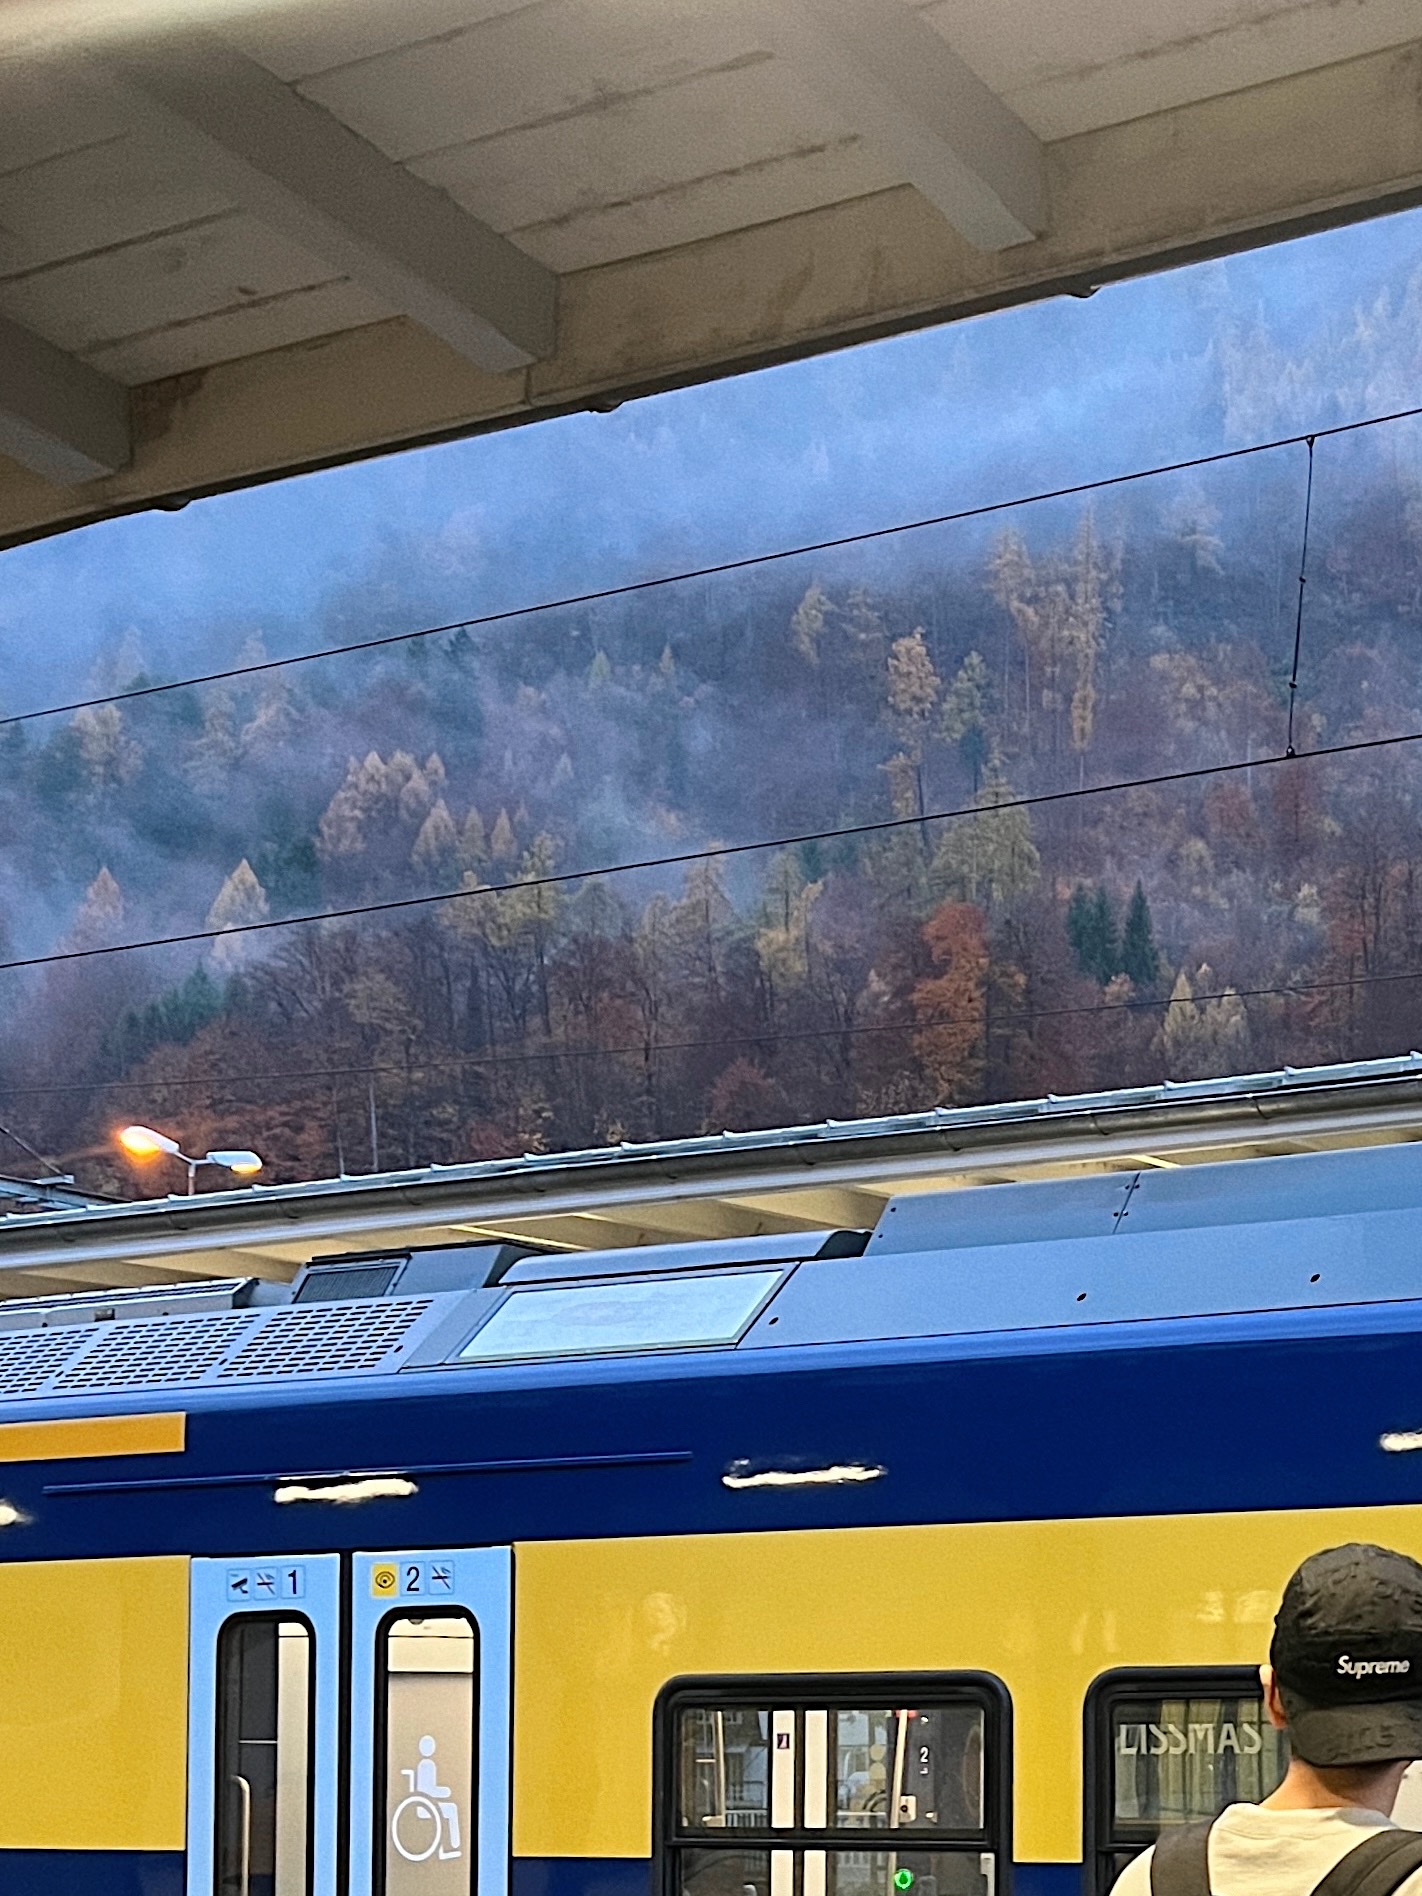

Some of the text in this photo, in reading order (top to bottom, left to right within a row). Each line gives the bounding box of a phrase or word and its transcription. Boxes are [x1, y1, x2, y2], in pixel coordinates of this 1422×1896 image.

[286, 1569, 297, 1595] 1
[406, 1566, 420, 1592] 2
[1336, 1655, 1411, 1680] Supreme
